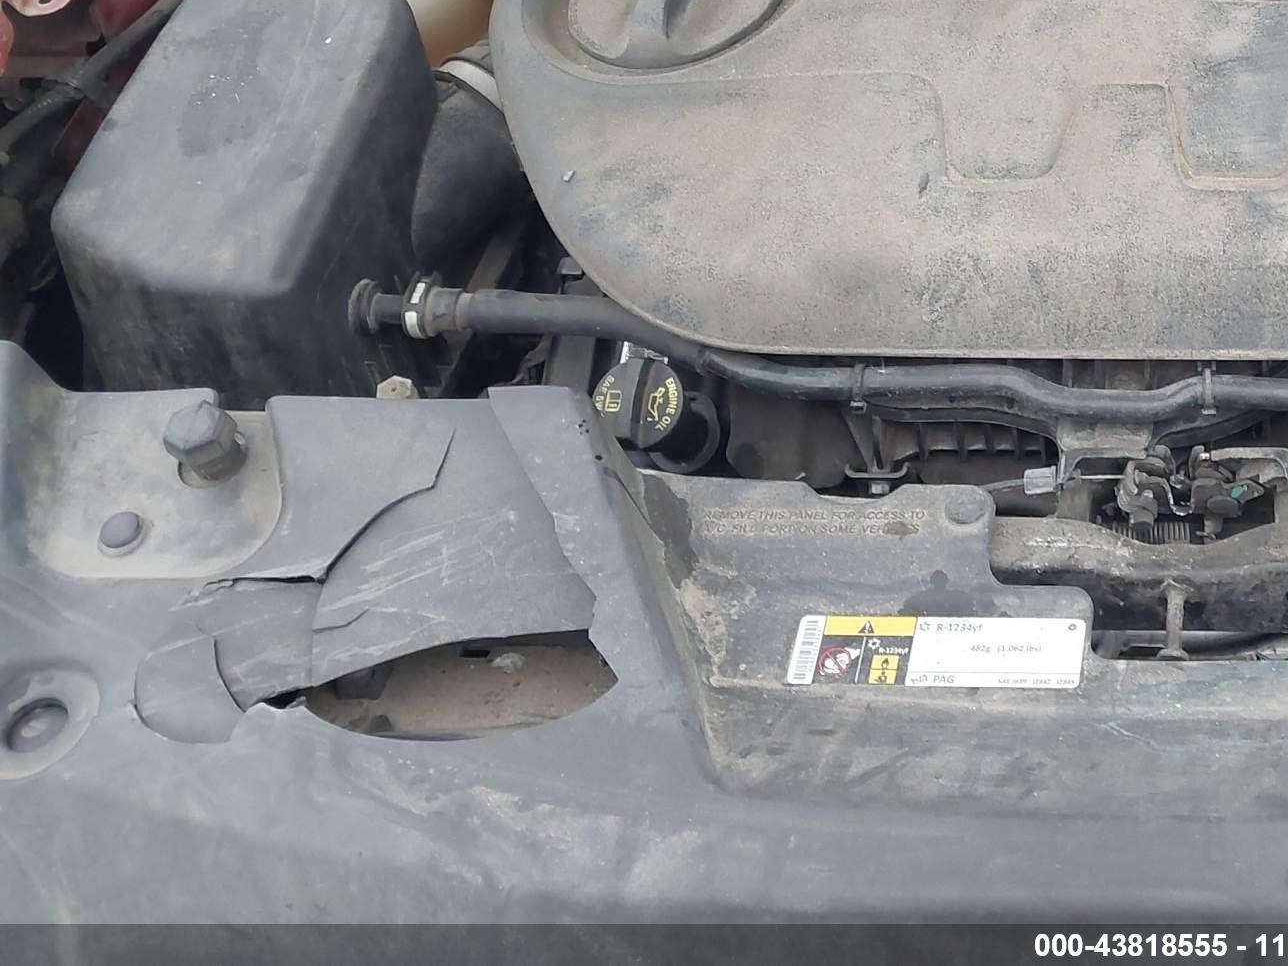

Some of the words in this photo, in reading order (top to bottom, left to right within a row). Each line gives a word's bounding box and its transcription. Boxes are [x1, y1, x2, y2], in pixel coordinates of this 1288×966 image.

[665, 377, 679, 415] ENGINE
[655, 416, 672, 431] OIL
[703, 509, 755, 520] REMOVE
[759, 509, 785, 520] THIS
[787, 509, 826, 520] PANEL
[832, 509, 855, 520] FOR
[860, 509, 906, 520] ACCESS
[910, 509, 926, 520] TO
[731, 522, 756, 533] FILL
[761, 522, 794, 534] PORT
[798, 523, 817, 534] ON
[820, 523, 856, 534] SOME
[936, 623, 983, 634] R-1234yf
[933, 675, 955, 684] PAG
